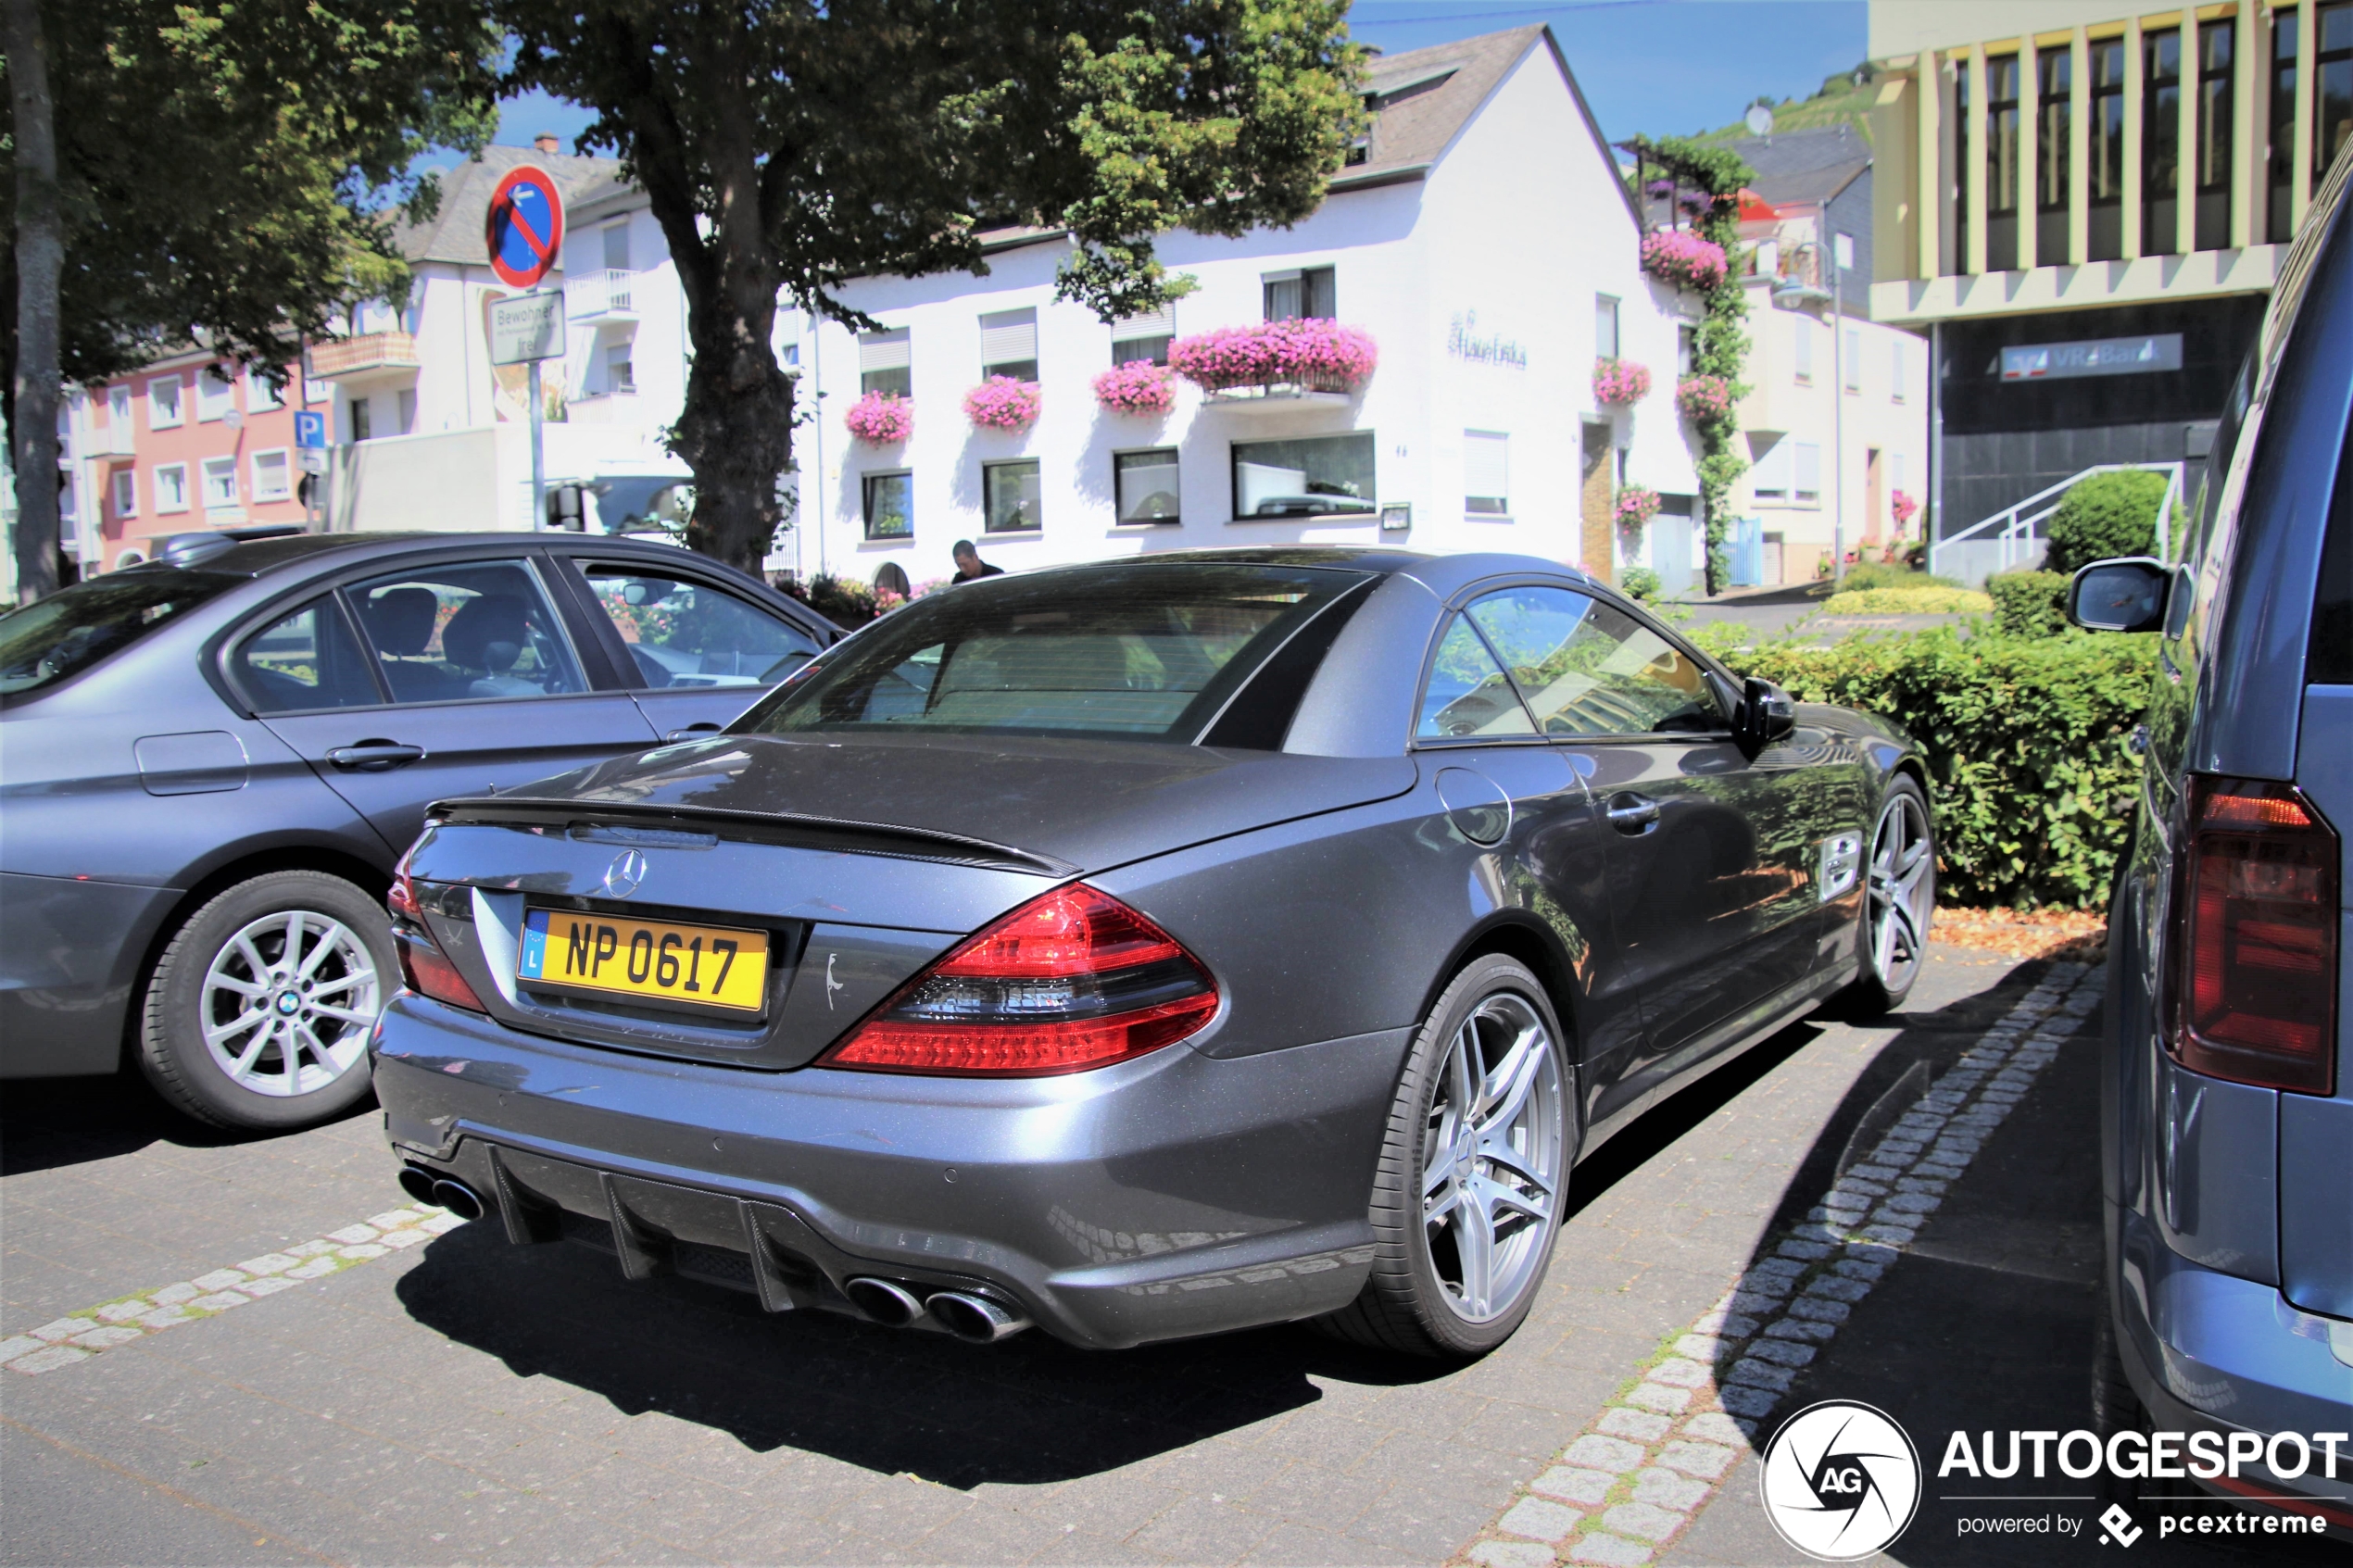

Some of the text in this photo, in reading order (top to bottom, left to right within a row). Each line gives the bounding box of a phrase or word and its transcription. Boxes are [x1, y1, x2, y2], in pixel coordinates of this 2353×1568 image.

[497, 305, 555, 325] Bewohner
[300, 415, 319, 445] P
[528, 950, 536, 969] L
[565, 922, 738, 995] NP 0617
[1408, 1077, 1435, 1202] Continental
